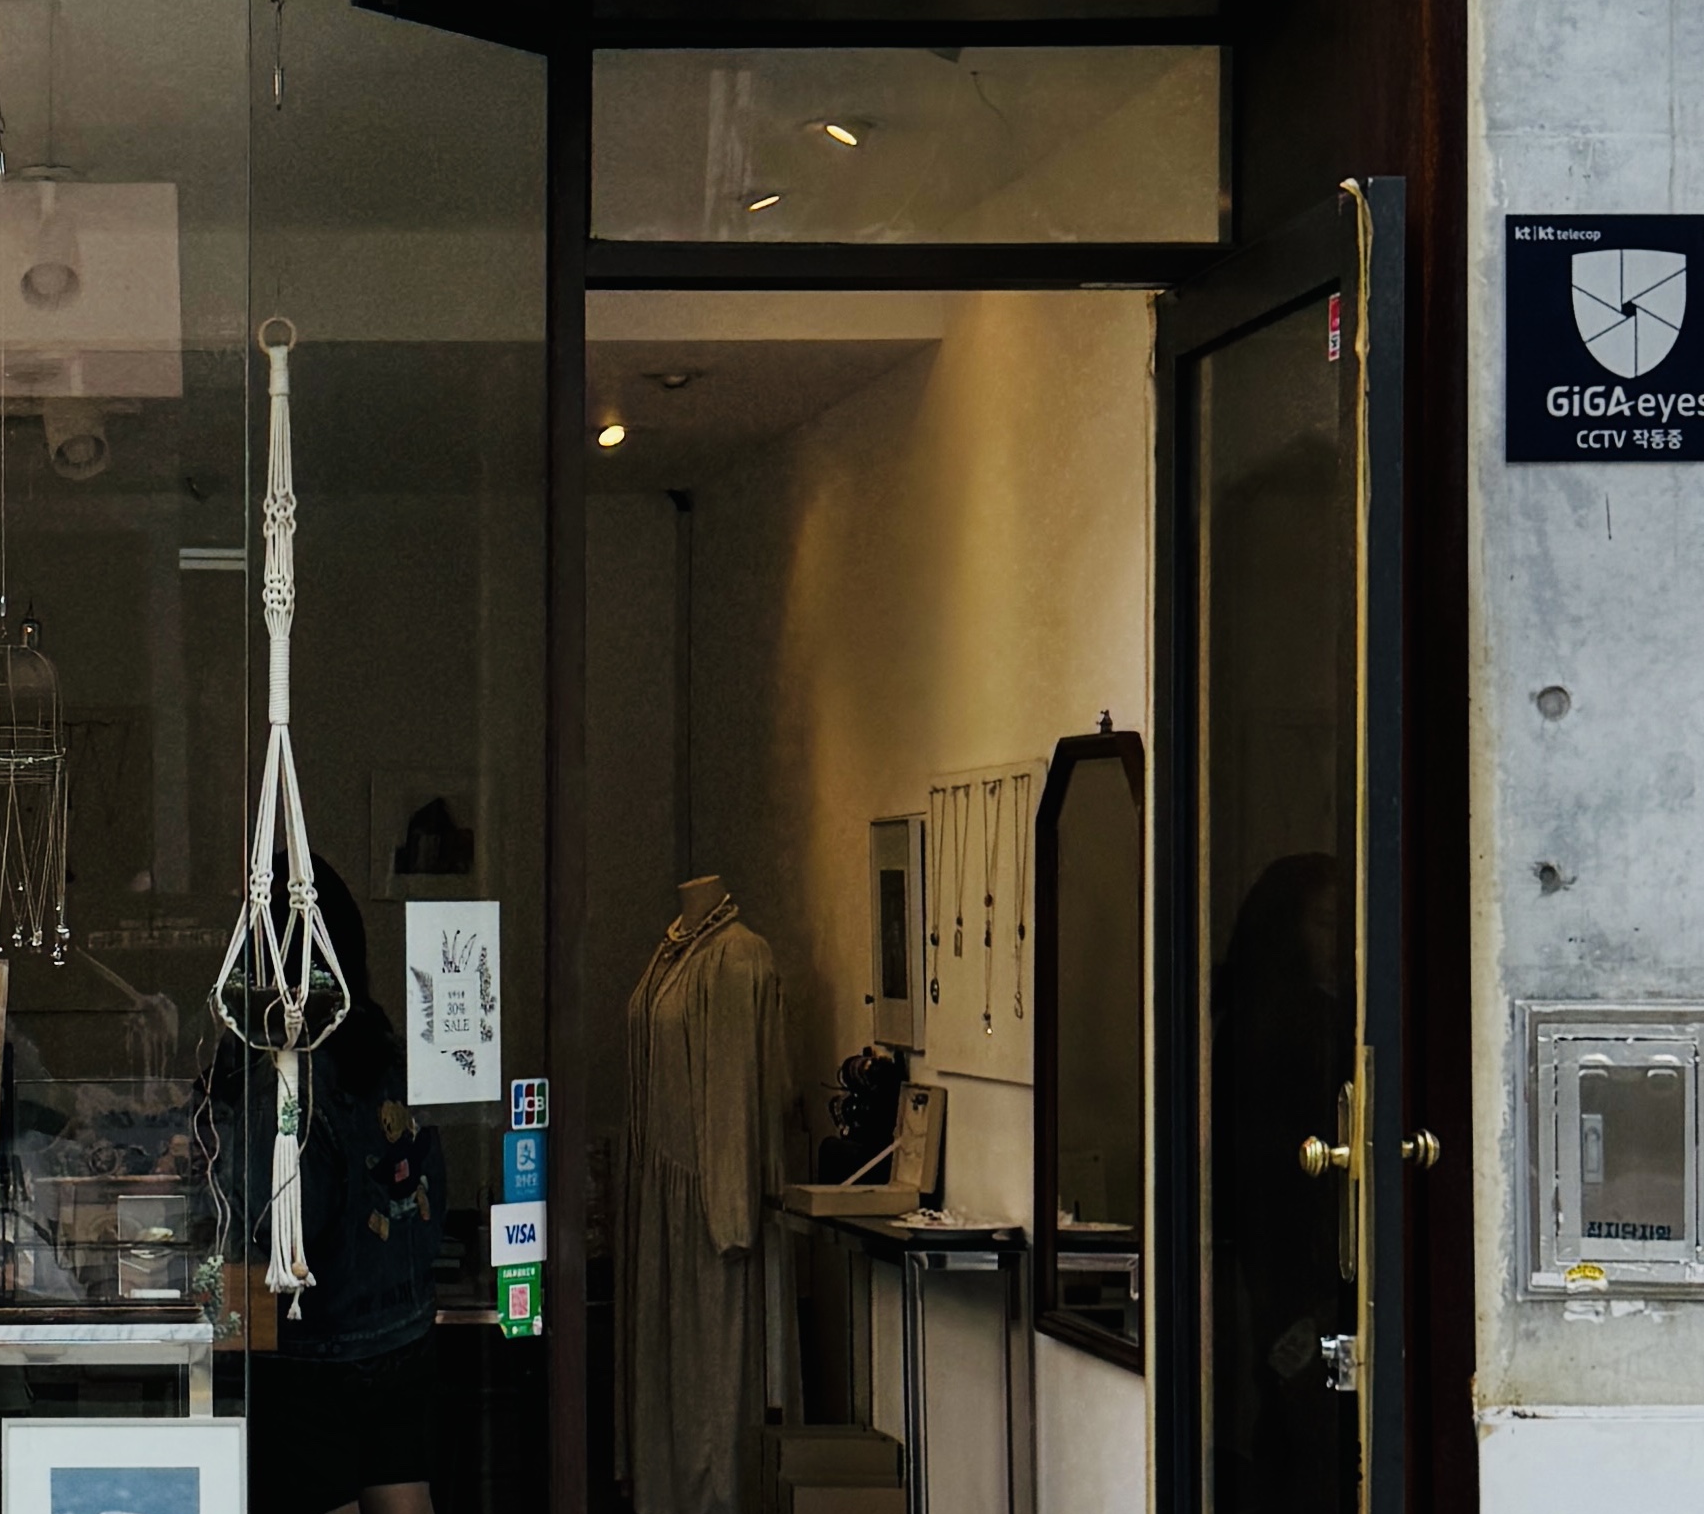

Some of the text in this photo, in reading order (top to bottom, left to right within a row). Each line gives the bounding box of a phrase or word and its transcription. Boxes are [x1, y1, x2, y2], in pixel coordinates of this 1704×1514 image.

[1556, 228, 1602, 242] telecop
[1546, 385, 1635, 417] GiGA
[1576, 429, 1683, 450] CCTV 작동중
[443, 1018, 470, 1033] SALE
[514, 1096, 545, 1113] JCB
[504, 1223, 537, 1245] VISA
